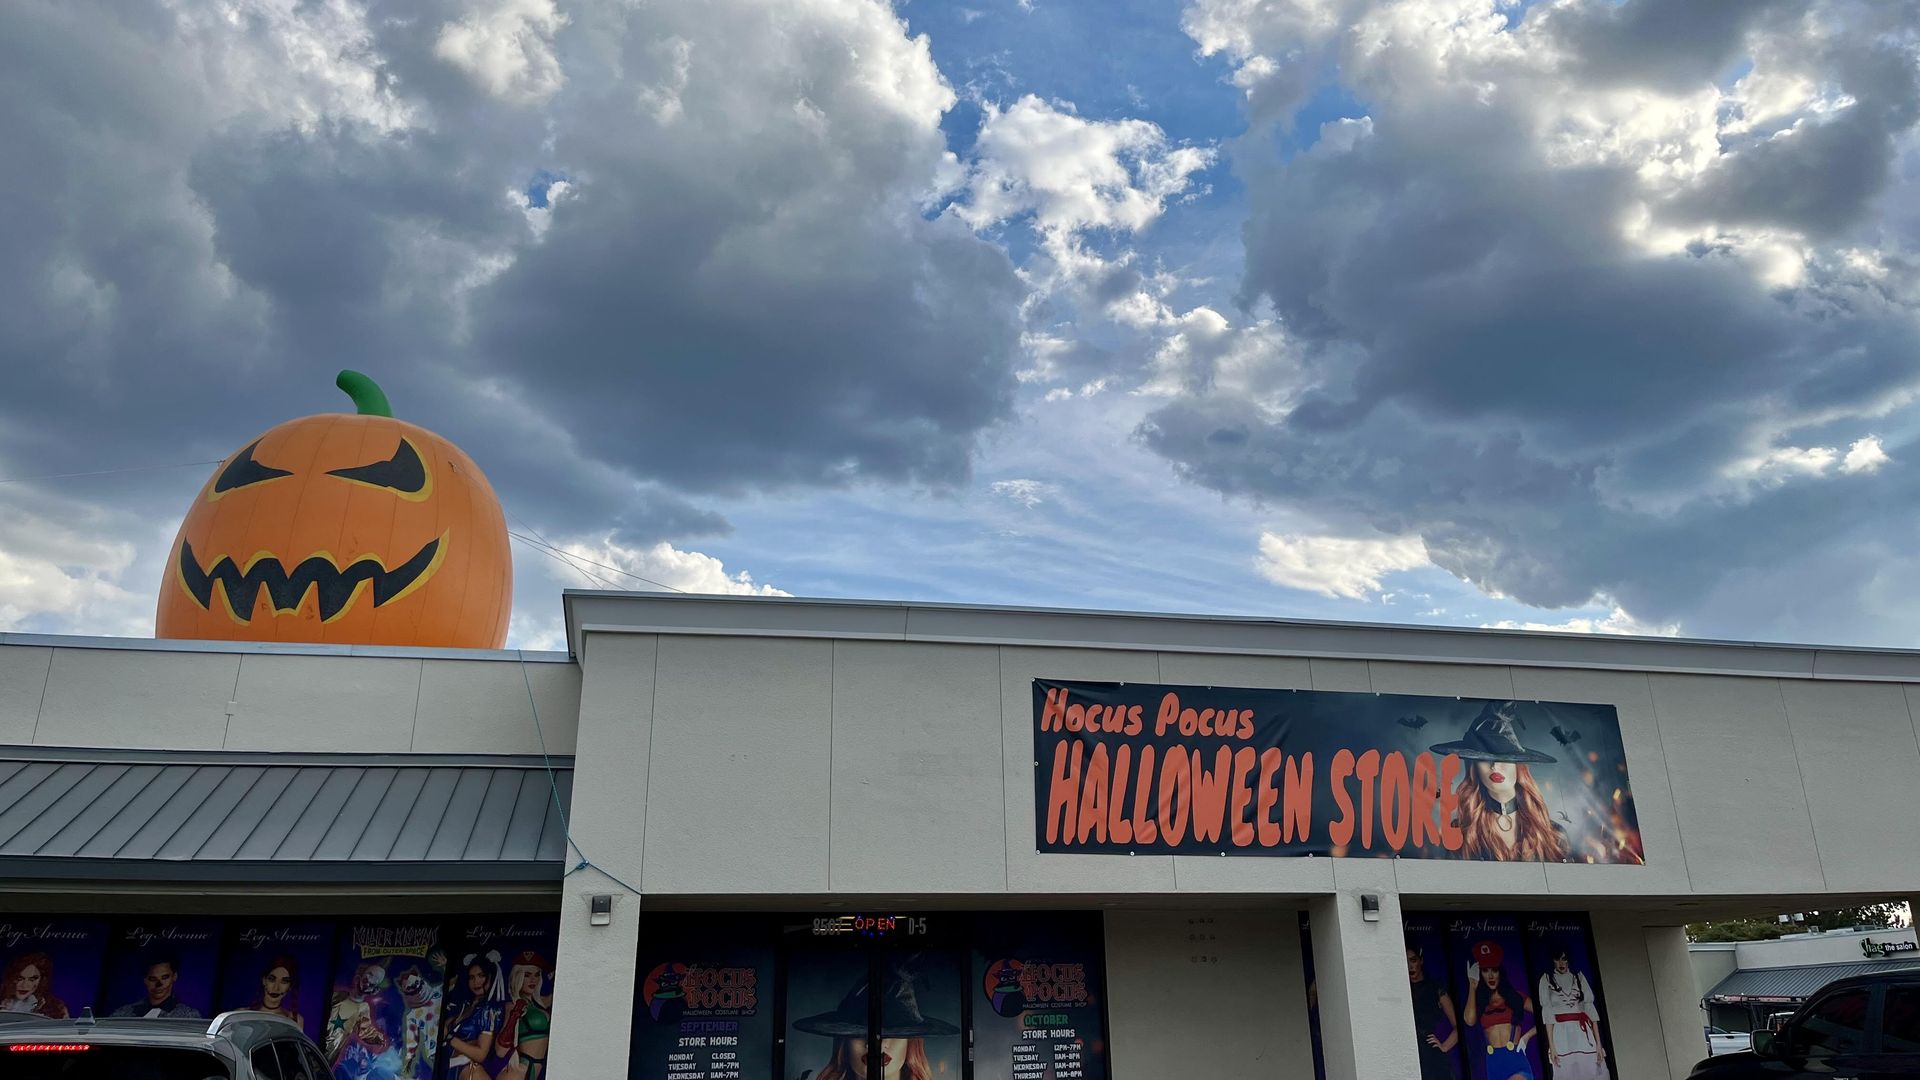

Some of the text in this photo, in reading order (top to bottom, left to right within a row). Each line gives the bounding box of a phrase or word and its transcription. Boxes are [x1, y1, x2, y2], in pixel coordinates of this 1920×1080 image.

[1046, 739, 1464, 851] HALLOWEEN STORE
[854, 917, 896, 930] OPEN
[908, 917, 926, 935] D-5
[1450, 918, 1516, 939] Leg Avenue
[1527, 919, 1581, 936] Leg Avenue
[24, 923, 88, 939] Avenue
[126, 925, 208, 947] Leg Avenue
[239, 926, 321, 949] Leg Avenue
[466, 924, 546, 945] Leg Avenue
[1885, 943, 1896, 951] the
[1896, 942, 1914, 951] salon
[681, 964, 756, 988] HOCUS
[1018, 960, 1085, 982] HOCUS
[685, 987, 758, 1009] POCUS
[1021, 981, 1088, 1002] POCUS
[681, 1021, 738, 1033] SEPTEMBER
[1024, 1014, 1069, 1027] OCTOBER
[1022, 1029, 1075, 1039] STORE HOURS
[679, 1036, 738, 1047] STORE HOURS
[668, 1052, 736, 1061] MONDAY CLOSED
[1013, 1054, 1039, 1062] TUESDAY
[668, 1062, 740, 1071] TUESDAY 11AM-7PM
[1013, 1062, 1047, 1071] WEDNESDAY
[667, 1071, 739, 1080] WEDNESDAY 11AM-7PM
[1014, 1071, 1044, 1080] THURSDAY
